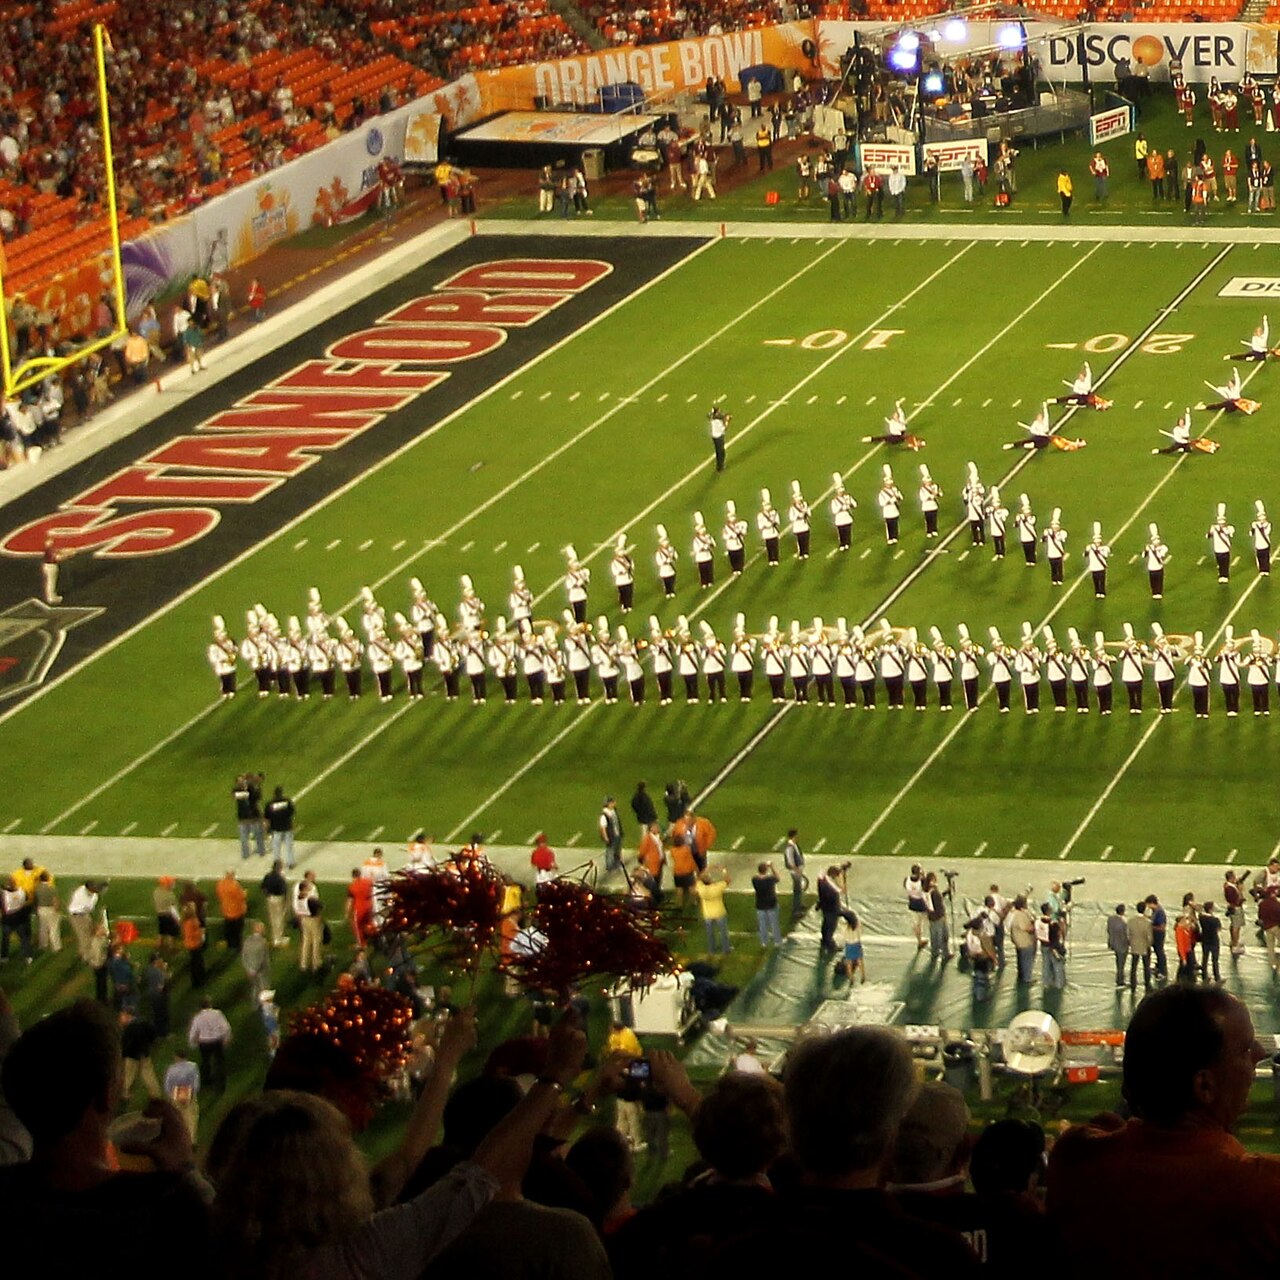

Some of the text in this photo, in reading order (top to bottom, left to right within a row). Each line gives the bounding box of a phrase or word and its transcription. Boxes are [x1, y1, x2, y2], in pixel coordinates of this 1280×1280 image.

[1050, 35, 1236, 67] DISCOVER
[535, 48, 674, 105] ORANGE
[1095, 112, 1126, 134] ESPN
[863, 149, 910, 163] ESPN
[1, 258, 614, 558] STANFORD
